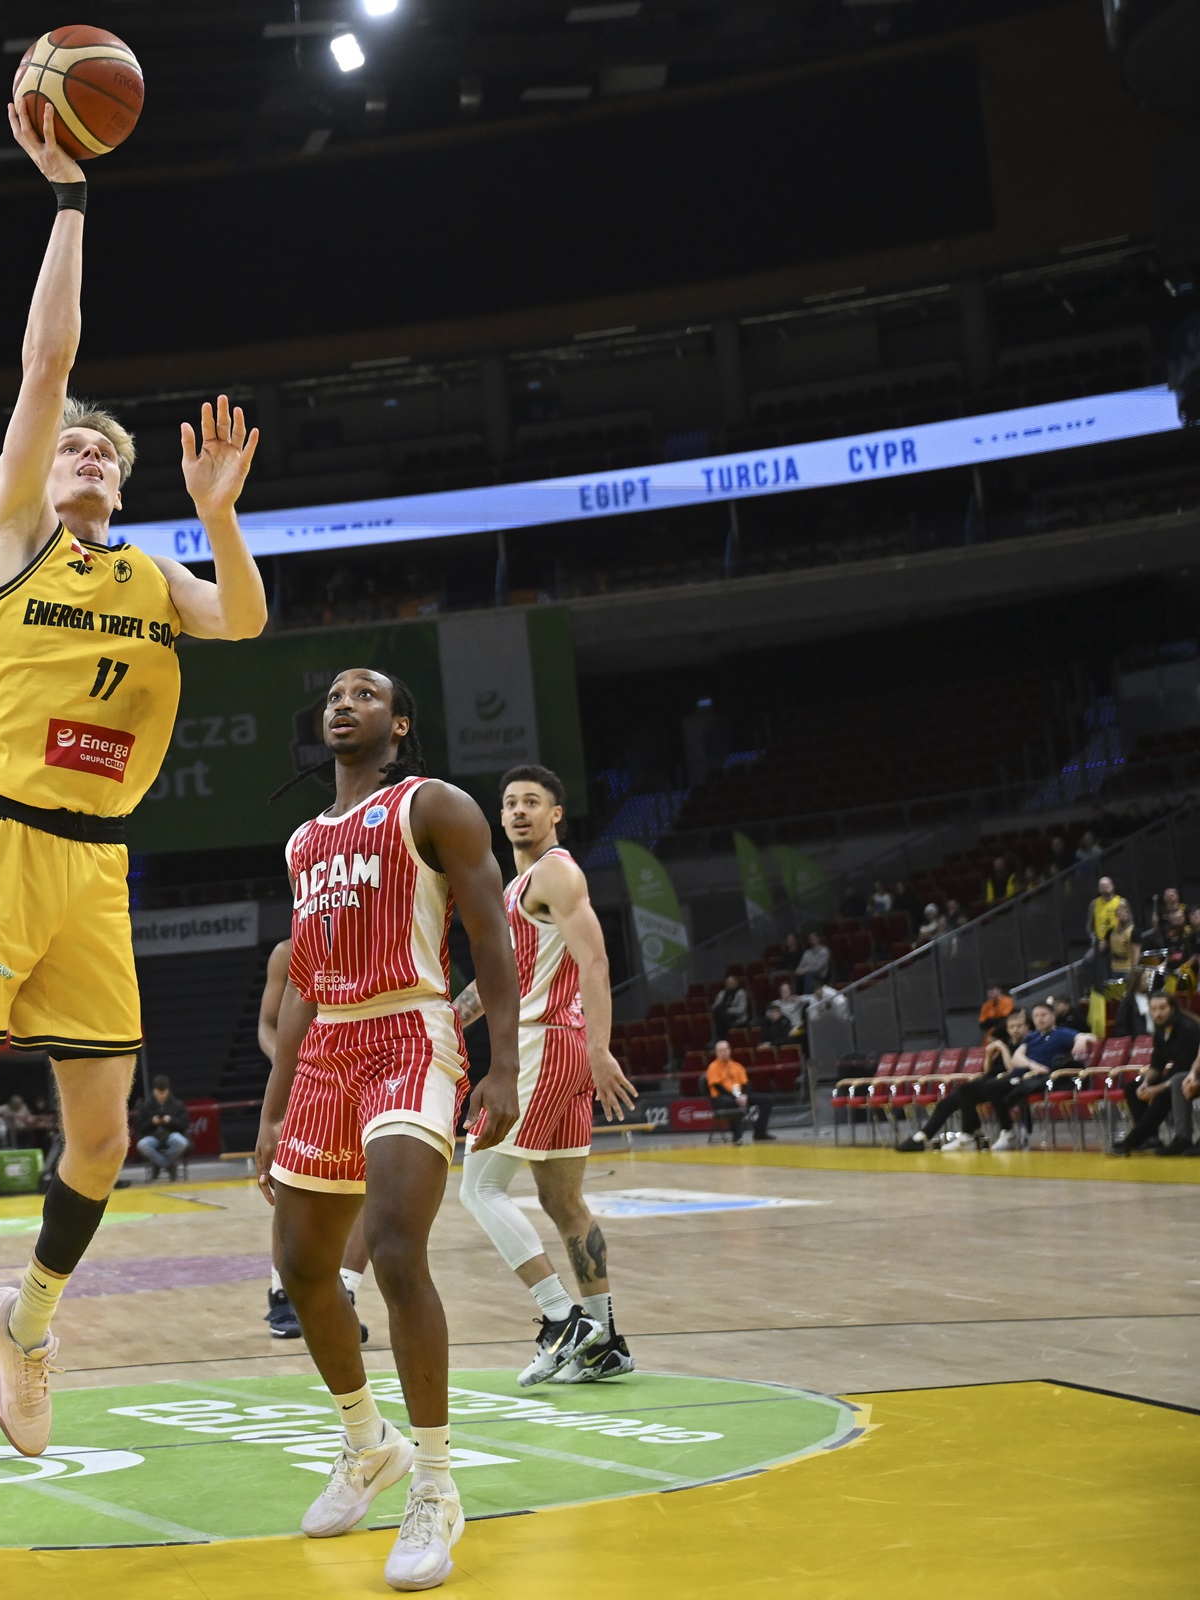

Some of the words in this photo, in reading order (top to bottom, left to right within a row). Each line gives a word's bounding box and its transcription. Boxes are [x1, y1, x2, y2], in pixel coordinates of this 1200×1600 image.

[578, 476, 652, 512] EGIPT
[701, 456, 799, 494] TURCJA
[848, 438, 918, 474] CYPR
[174, 527, 211, 555] CY
[23, 598, 94, 631] ENERGA
[99, 613, 145, 640] TREFL
[89, 656, 130, 701] 11
[80, 733, 129, 759] Energa
[80, 753, 105, 765] GRUPA
[293, 853, 380, 911] UCAM
[299, 889, 361, 923] MURCIA
[321, 914, 333, 953] 1
[314, 983, 325, 991] DE
[644, 1106, 670, 1126] 122
